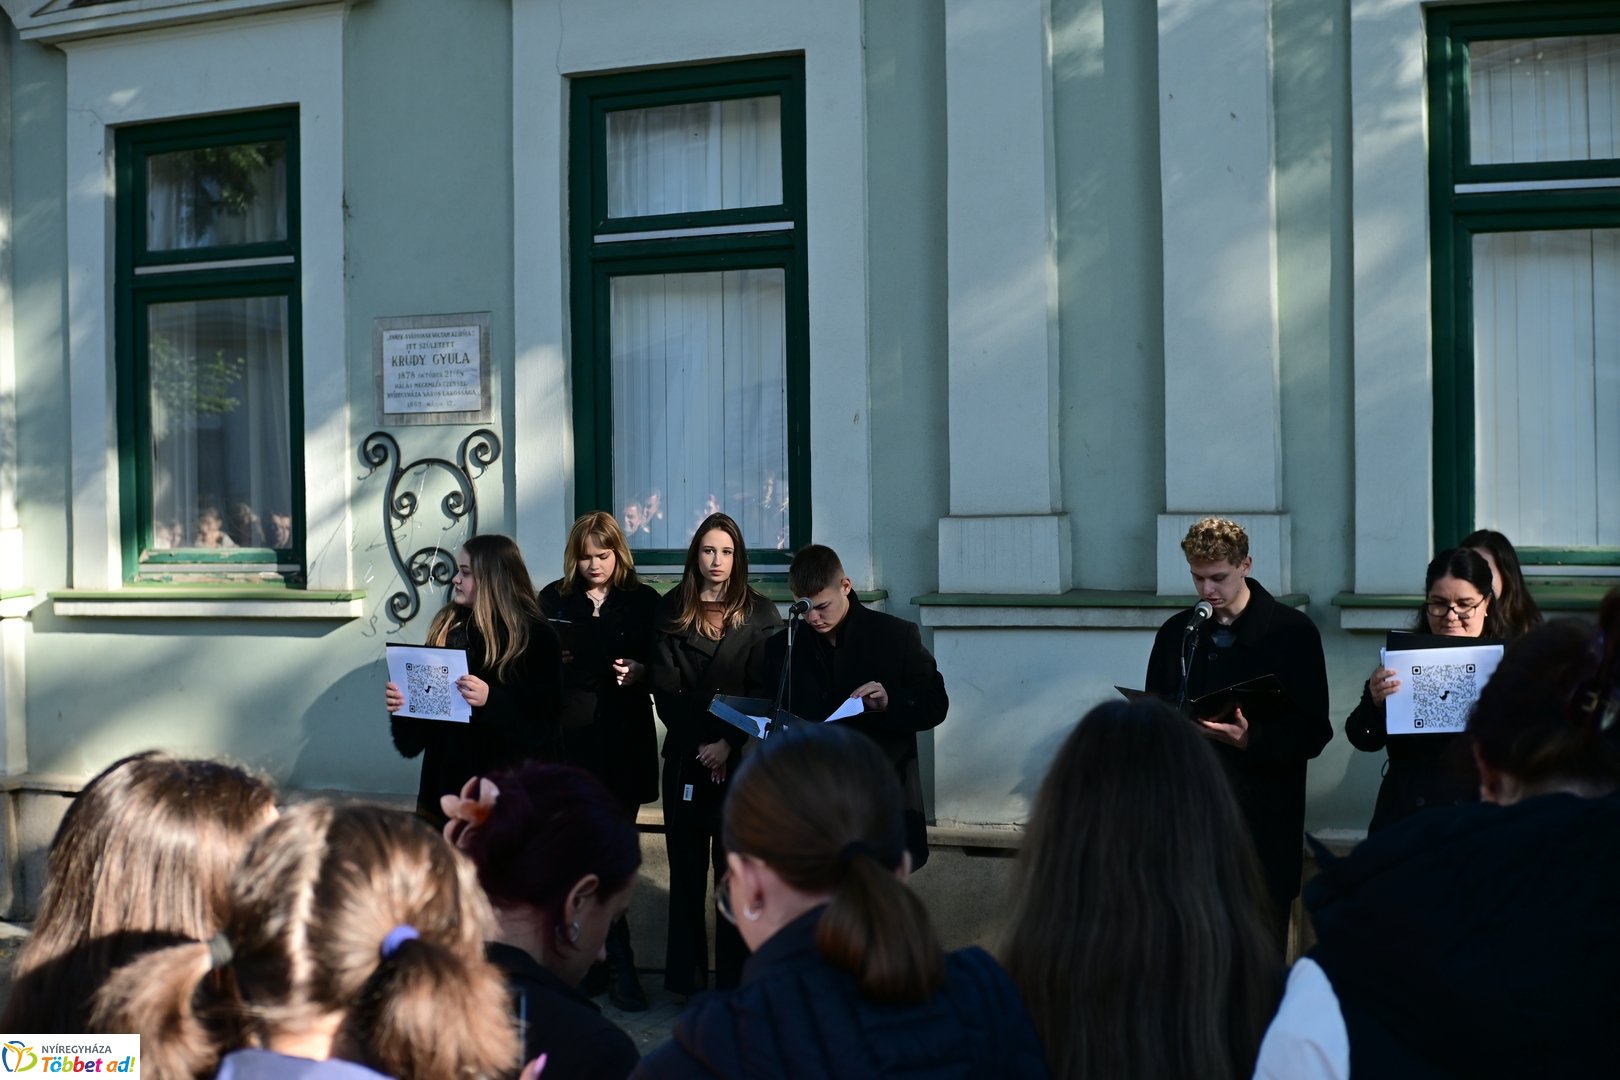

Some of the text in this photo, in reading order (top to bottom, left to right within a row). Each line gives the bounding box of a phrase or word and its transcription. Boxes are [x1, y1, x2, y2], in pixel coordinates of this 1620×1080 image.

[391, 350, 470, 367] KRÚDY GYULA
[398, 371, 415, 379] 1878
